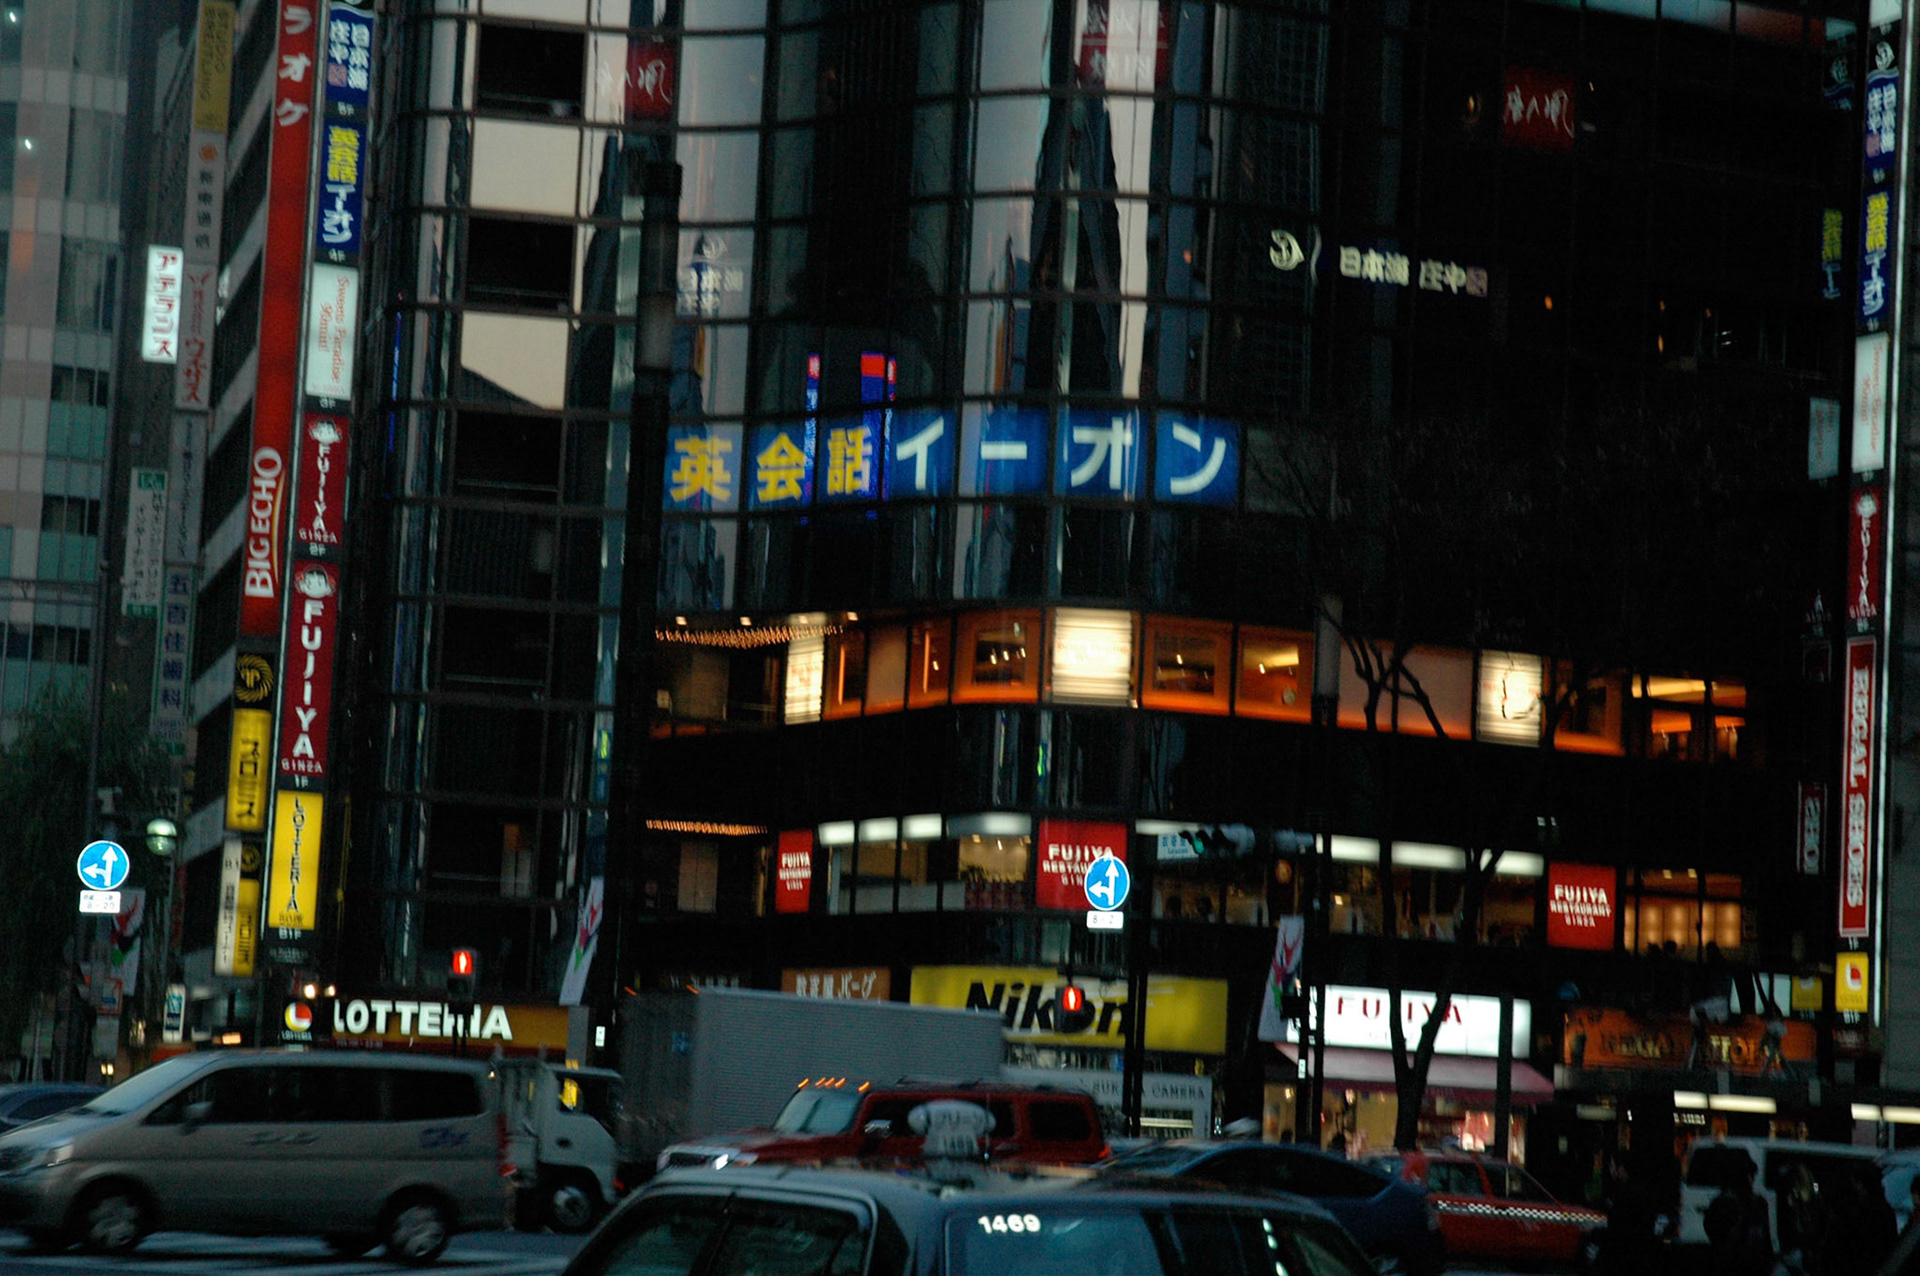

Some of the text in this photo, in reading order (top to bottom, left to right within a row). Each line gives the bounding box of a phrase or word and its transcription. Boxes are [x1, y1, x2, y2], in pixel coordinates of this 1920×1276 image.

[276, 4, 312, 127] ラオケ
[312, 443, 331, 532] FUJIYA
[292, 599, 324, 759] FUJIYA
[281, 757, 323, 774] GINZA
[1847, 666, 1869, 908] REGAL SHOES
[287, 795, 305, 912] LOTTERIA
[781, 852, 810, 868] FUJIYA
[1048, 843, 1114, 862] FUJIYA
[1554, 884, 1607, 904] FUJIYA
[1550, 899, 1611, 917] RESTAURANT
[1338, 996, 1462, 1026] FUIA
[978, 1213, 1041, 1234] 1469
